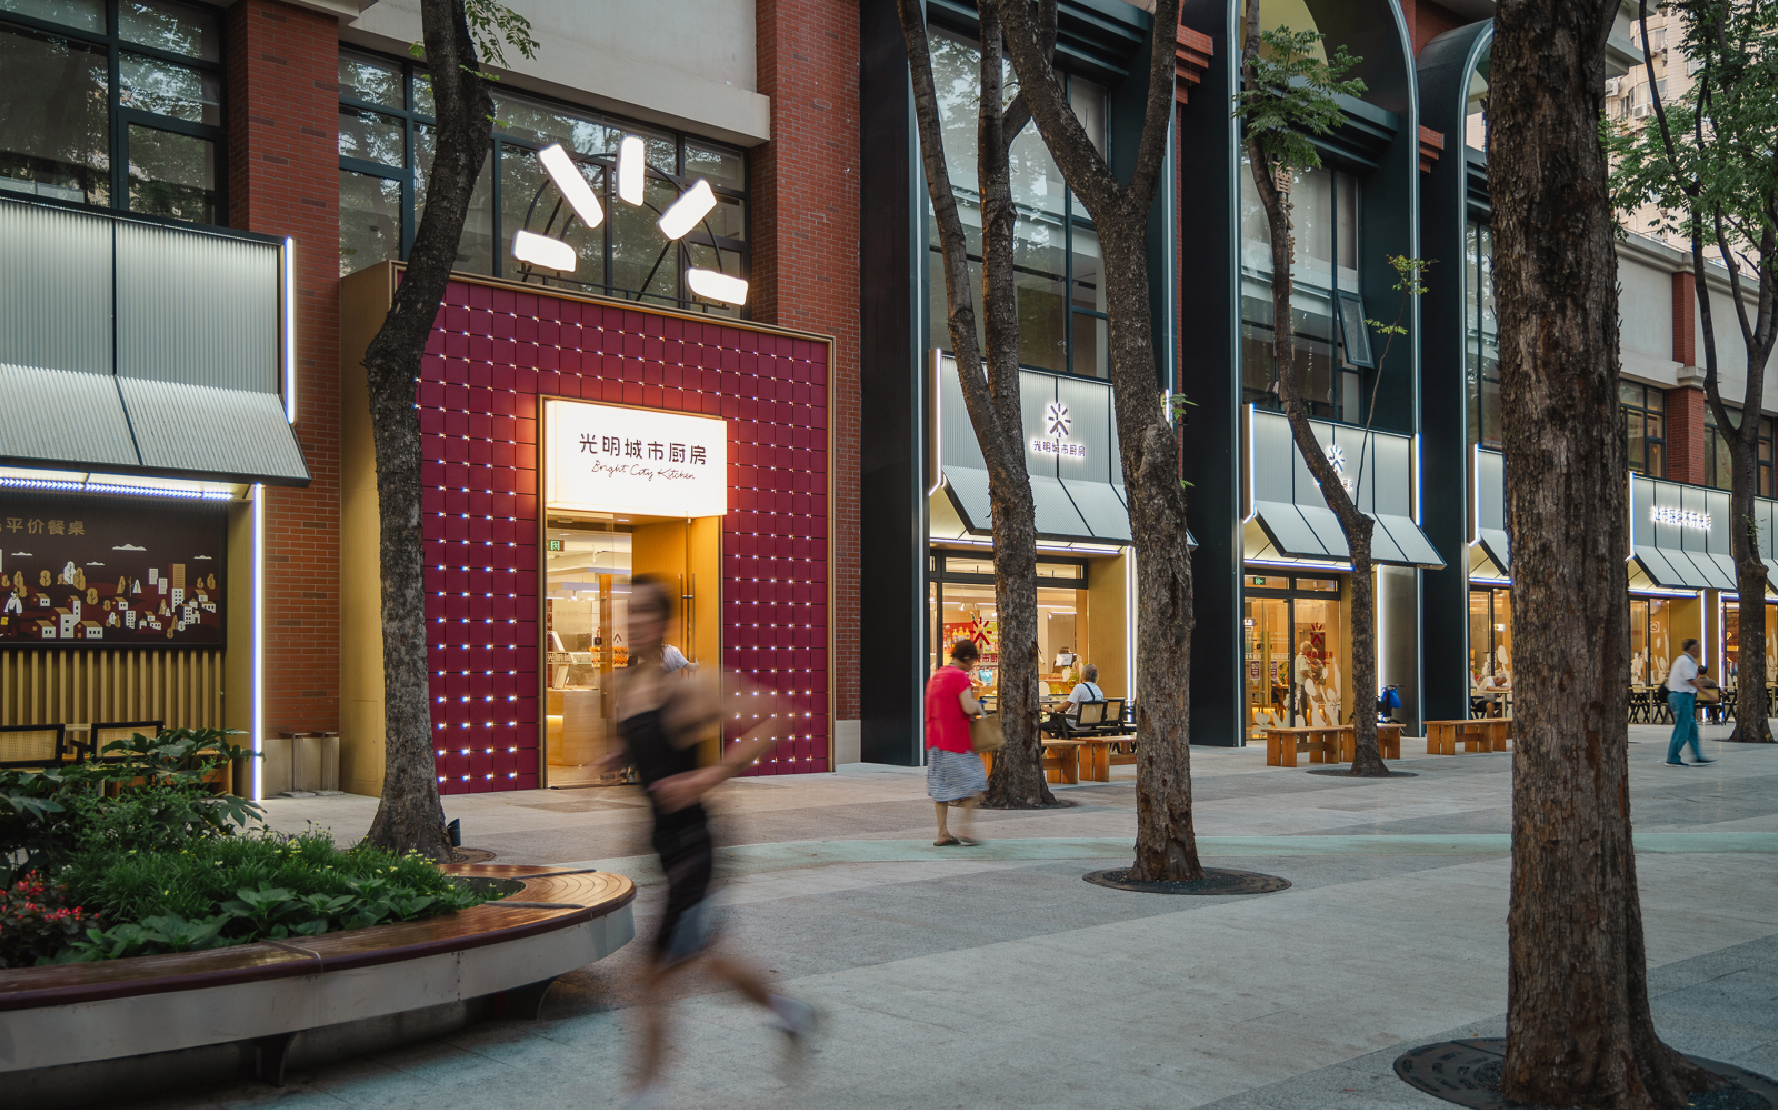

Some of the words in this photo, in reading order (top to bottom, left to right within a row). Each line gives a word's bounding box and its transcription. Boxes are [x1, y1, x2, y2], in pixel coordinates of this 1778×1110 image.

[579, 433, 707, 466] 光明城市厨房
[591, 459, 629, 478] Bright
[630, 463, 654, 482] City
[657, 467, 697, 481] Kitchen
[0, 516, 86, 536] 平价餐桌
